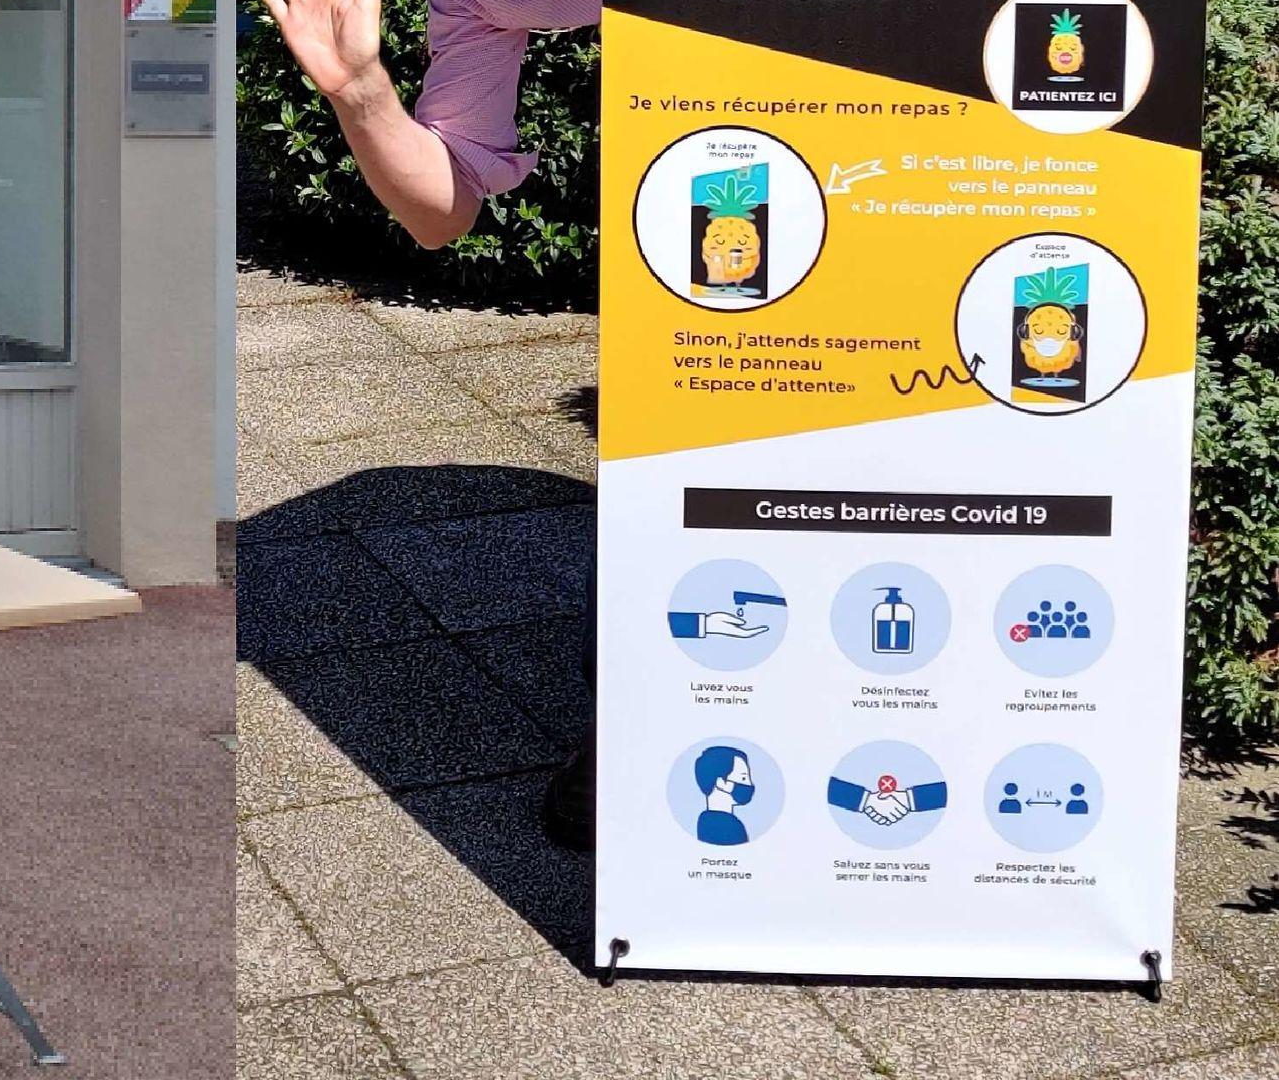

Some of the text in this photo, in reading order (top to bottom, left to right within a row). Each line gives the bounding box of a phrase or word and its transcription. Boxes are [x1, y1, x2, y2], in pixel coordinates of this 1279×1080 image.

[1020, 91, 1116, 102] PATIENTEZ ICI
[630, 95, 969, 118] Je viens récupérer mon repas ?
[902, 154, 1098, 175] Si c'est libre, je fonce
[949, 179, 1096, 196] vers le panneau
[850, 198, 1096, 219] « Je récupère mon repas »
[675, 331, 920, 352] Sinon, j'attends sagement
[674, 354, 821, 372] vers le panneau
[675, 377, 855, 393] « Espace d'attente»
[756, 501, 1047, 524] Gestes barrières Covid 19
[691, 682, 723, 691] Lavez
[862, 687, 929, 696] Désinfectez
[1025, 689, 1077, 698] Evitez les
[695, 695, 749, 704] les mains
[883, 699, 898, 708] les
[902, 700, 938, 709] mains
[1006, 703, 1096, 712] regroupements
[702, 858, 738, 866] Portez
[834, 860, 871, 869] Saluez
[996, 863, 1075, 873] Respectez les
[706, 872, 752, 880] masque
[873, 873, 888, 881] les
[892, 874, 926, 882] mains
[974, 874, 1096, 885] distances de sécurité
